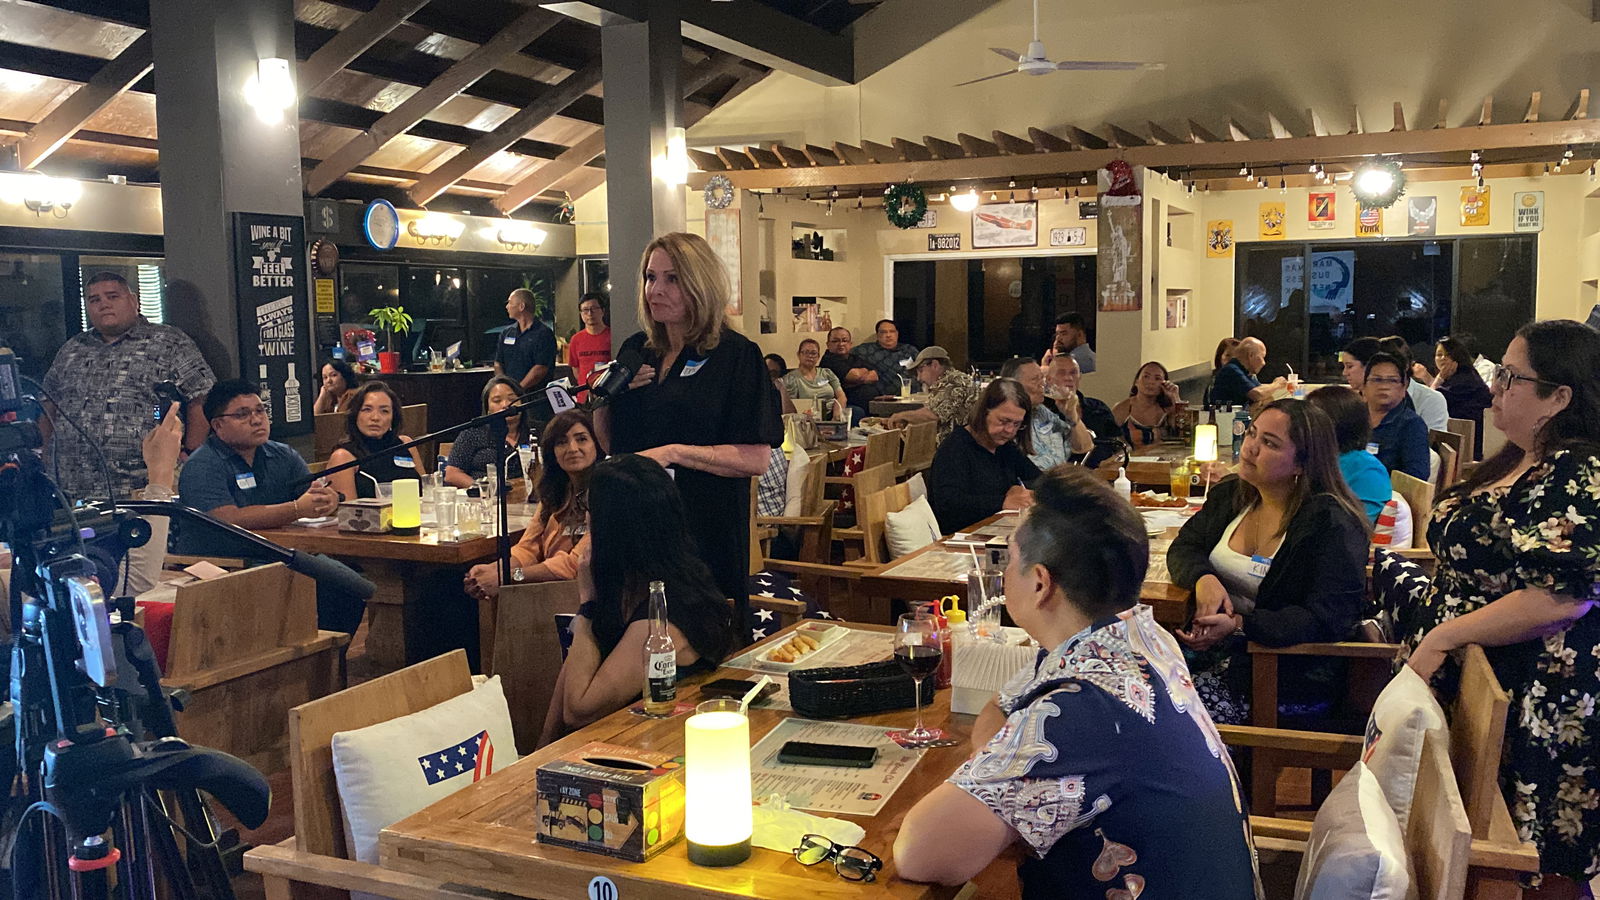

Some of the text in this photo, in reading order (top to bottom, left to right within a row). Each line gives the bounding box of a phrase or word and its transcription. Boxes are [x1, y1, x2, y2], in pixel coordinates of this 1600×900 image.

[1518, 208, 1539, 216] WINK
[250, 224, 292, 243] WINE A BIT
[1360, 225, 1380, 233] YORK
[261, 263, 285, 274] FEEL
[252, 275, 294, 287] BETTER
[256, 306, 293, 325] ALWAYS
[263, 327, 274, 339] FOR
[277, 320, 295, 338] GLASS
[263, 341, 295, 356] WINE
[584, 769, 611, 778] AWAY
[610, 773, 633, 782] TOW
[594, 881, 612, 900] 10
